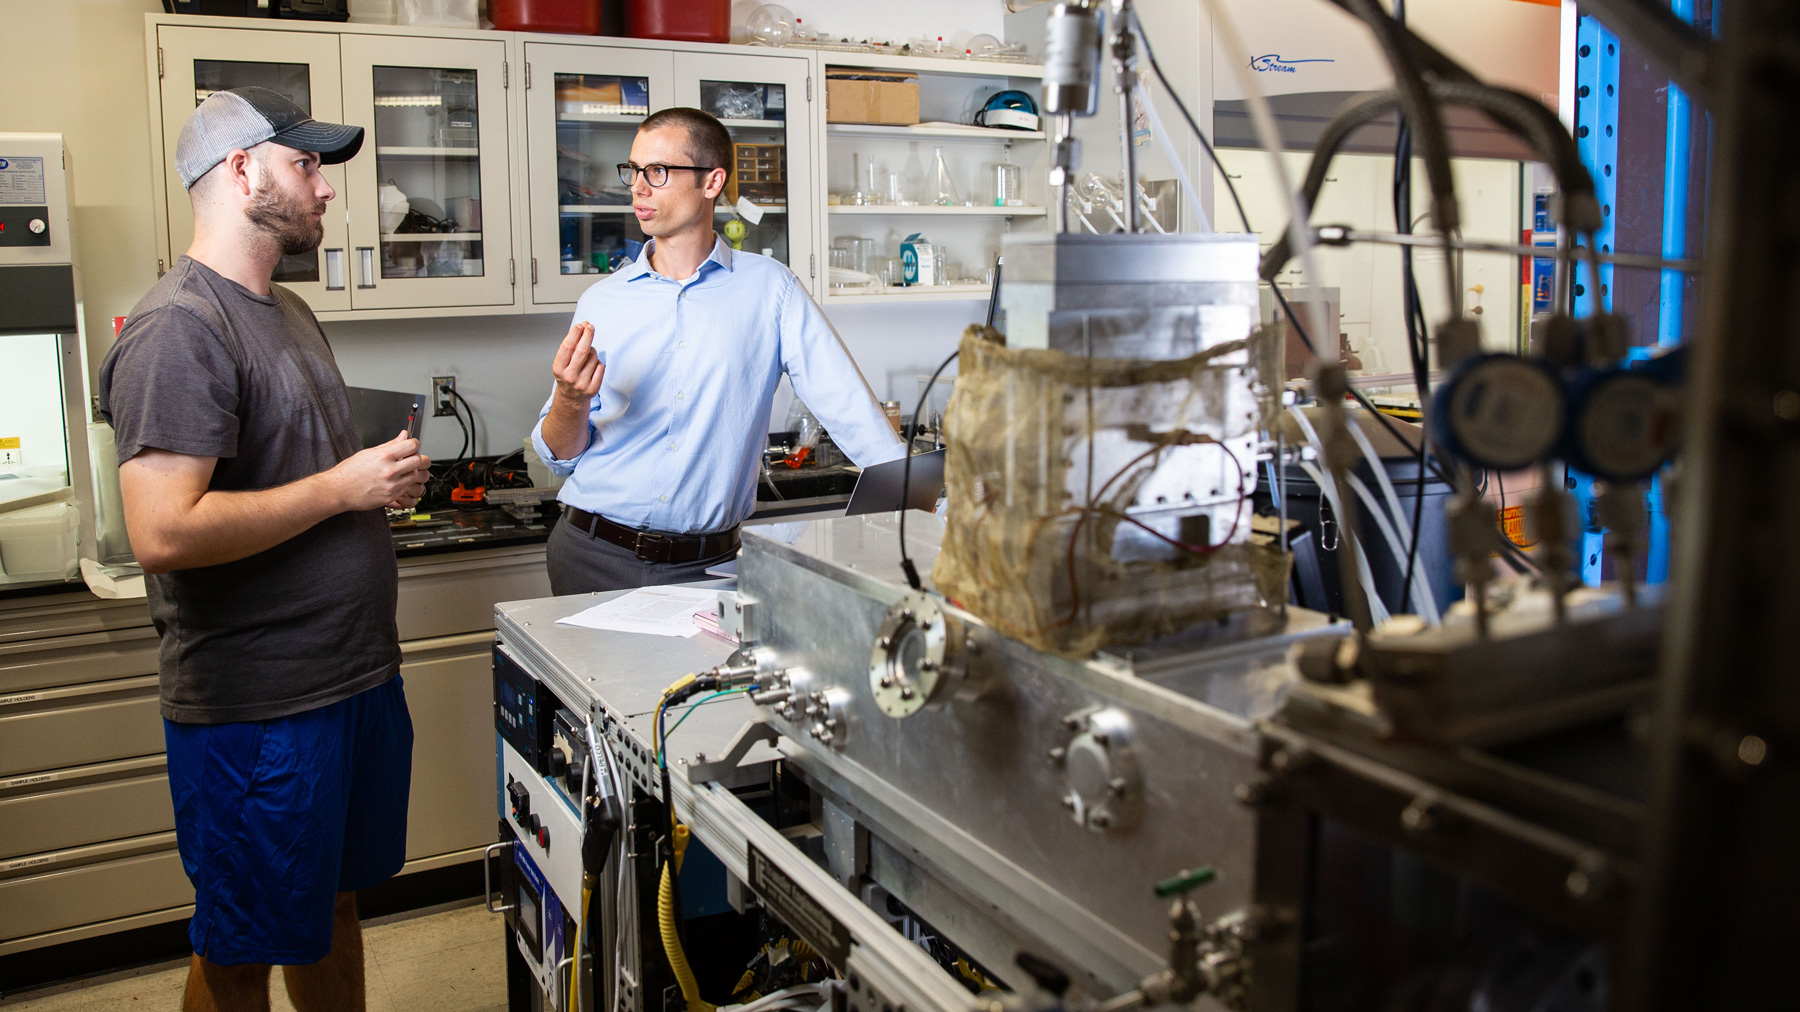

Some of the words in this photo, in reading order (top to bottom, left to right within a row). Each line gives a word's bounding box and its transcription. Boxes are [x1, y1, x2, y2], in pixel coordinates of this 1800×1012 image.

[1498, 509, 1526, 521] CAUTIO
[594, 744, 606, 768] PELCO
[29, 775, 51, 783] HOLDERS
[28, 857, 49, 865] HOLDERS
